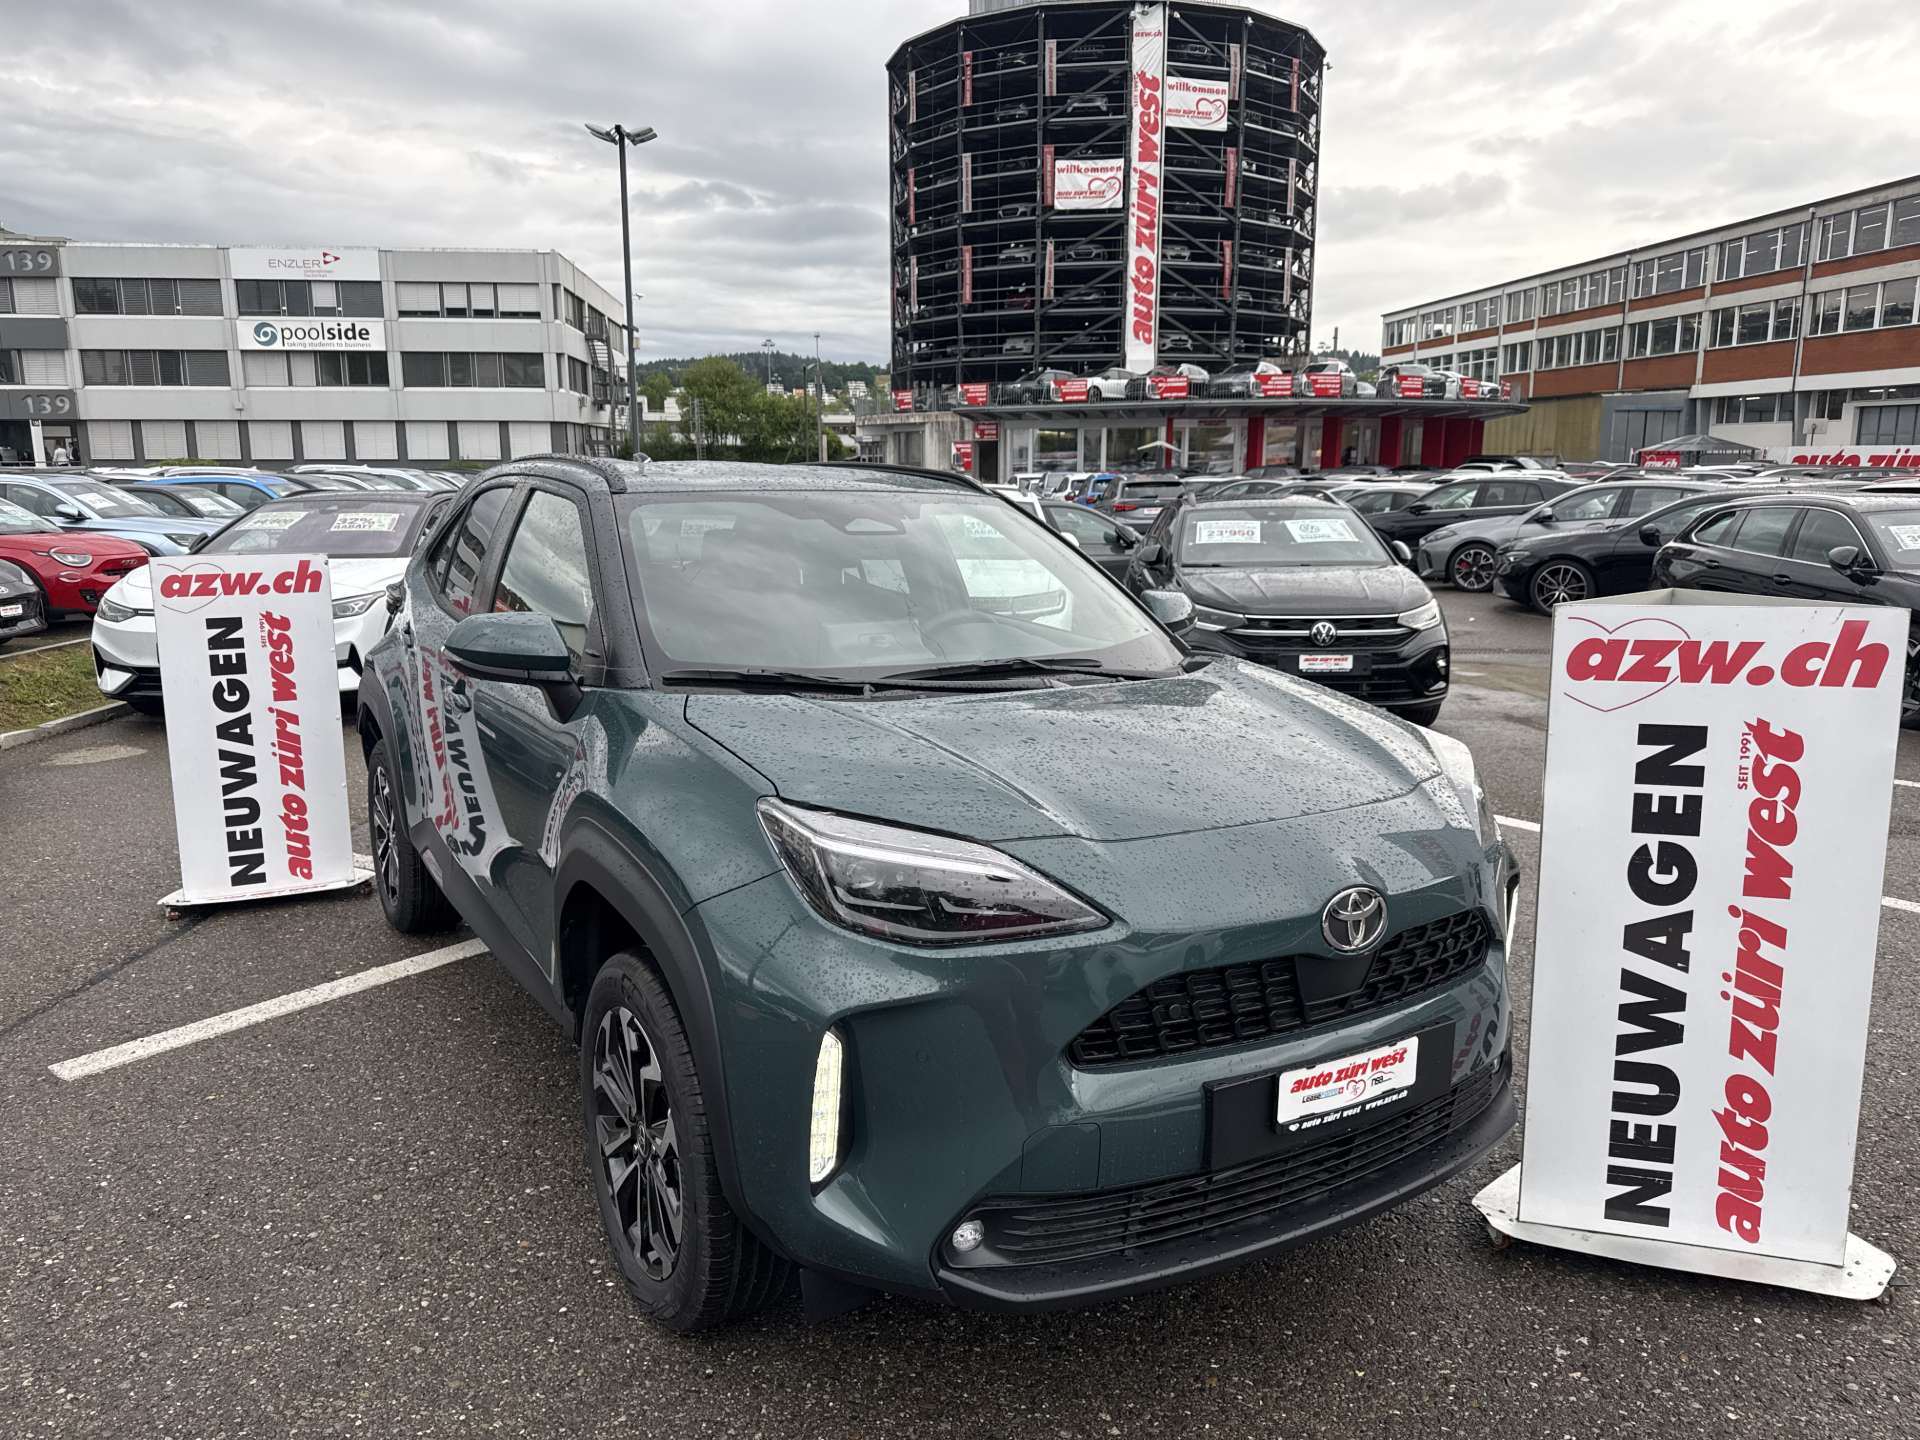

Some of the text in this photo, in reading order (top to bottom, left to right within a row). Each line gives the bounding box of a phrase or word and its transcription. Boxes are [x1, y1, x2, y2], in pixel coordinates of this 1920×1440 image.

[1167, 81, 1227, 95] willkommen
[1056, 164, 1122, 175] willkommen
[1130, 70, 1160, 345] auto züri west
[2, 251, 53, 272] 139
[267, 258, 321, 269] ENZLER
[280, 322, 371, 347] poolside
[287, 341, 307, 349] taking
[22, 394, 71, 415] 139
[160, 560, 322, 598] azw.ch
[260, 634, 268, 649] SEIT
[1565, 619, 1890, 689] azw.ch
[205, 616, 267, 887] NEUWAGEN
[259, 611, 313, 881] auto züri west
[1737, 730, 1751, 791] SEIT 1991
[1604, 723, 1709, 1228] NEUWAGEN
[1711, 717, 1805, 1244] auto züri west
[1290, 1047, 1408, 1094] auto züri west
[1301, 1117, 1322, 1130] auto
[1342, 1105, 1362, 1118] west
